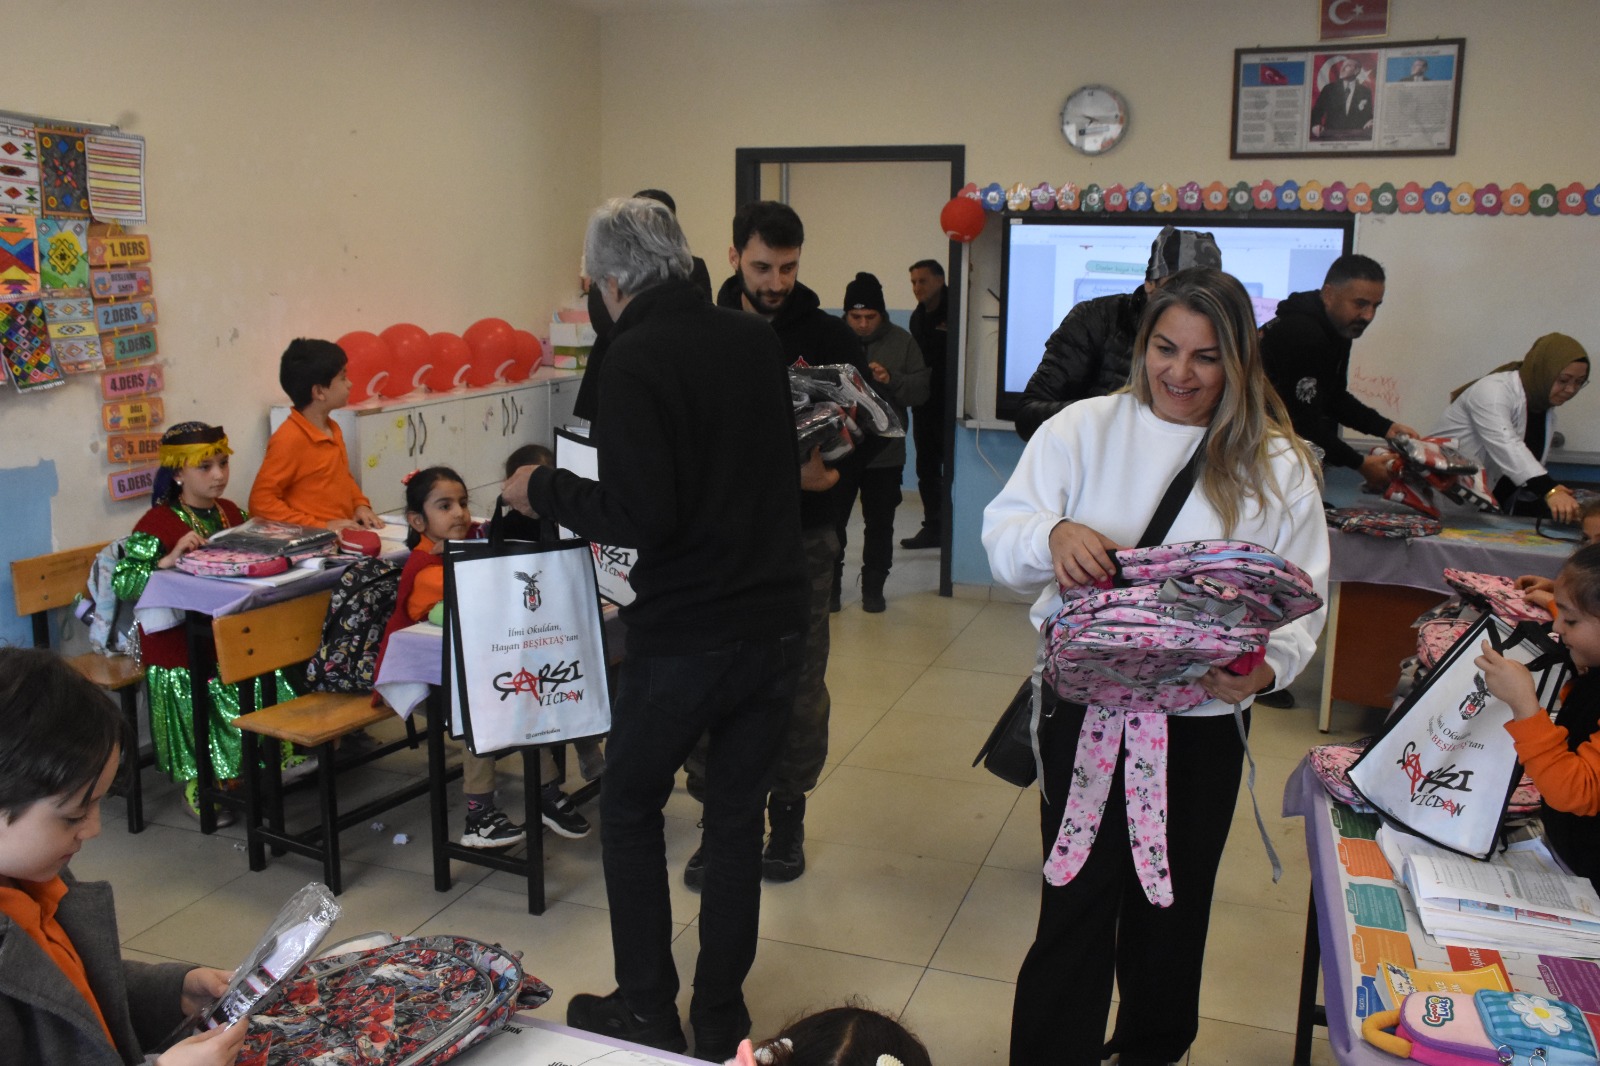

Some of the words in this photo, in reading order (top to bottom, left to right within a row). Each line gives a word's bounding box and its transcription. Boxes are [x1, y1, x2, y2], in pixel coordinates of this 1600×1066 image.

[120, 241, 145, 257] DERS
[103, 306, 138, 325] 2.DERS
[119, 335, 152, 355] 3.DERS
[110, 373, 145, 392] 4.DERS
[128, 441, 137, 455] 5.
[117, 473, 153, 493] 6.DERS
[591, 542, 632, 567] ARŞI
[508, 626, 525, 638] İlmi
[527, 622, 562, 635] Okuldan,
[491, 642, 520, 654] Hayatı
